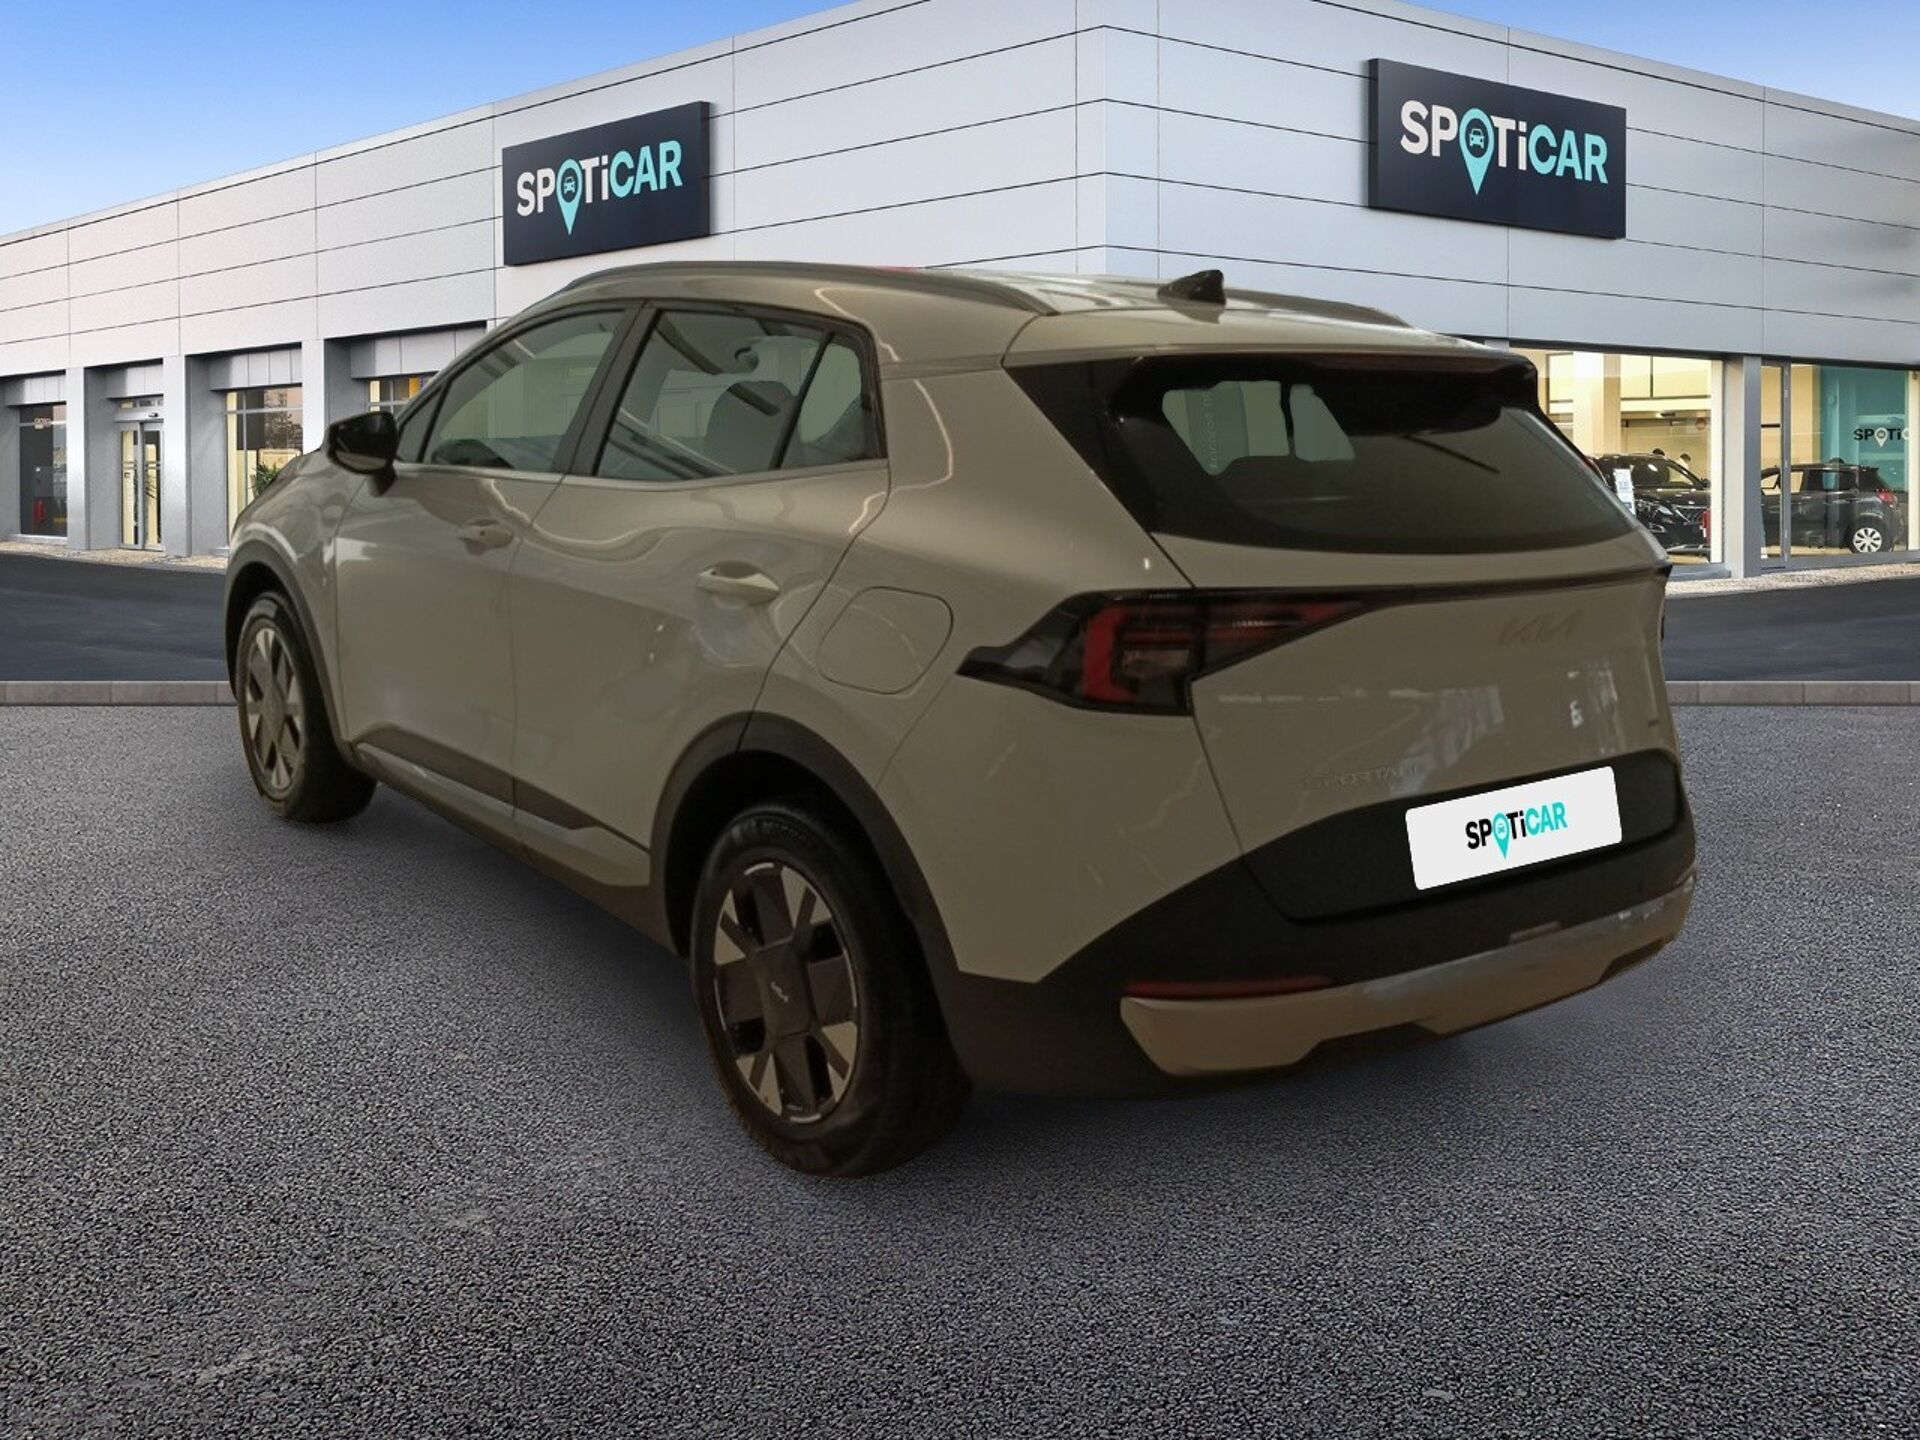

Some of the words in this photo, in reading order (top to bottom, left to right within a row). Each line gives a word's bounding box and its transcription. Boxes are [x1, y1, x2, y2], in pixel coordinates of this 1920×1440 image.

[516, 140, 683, 235] SPOTiCAR
[1400, 99, 1609, 196] SPOTiCAR
[1465, 801, 1568, 860] SPOTiCAR
